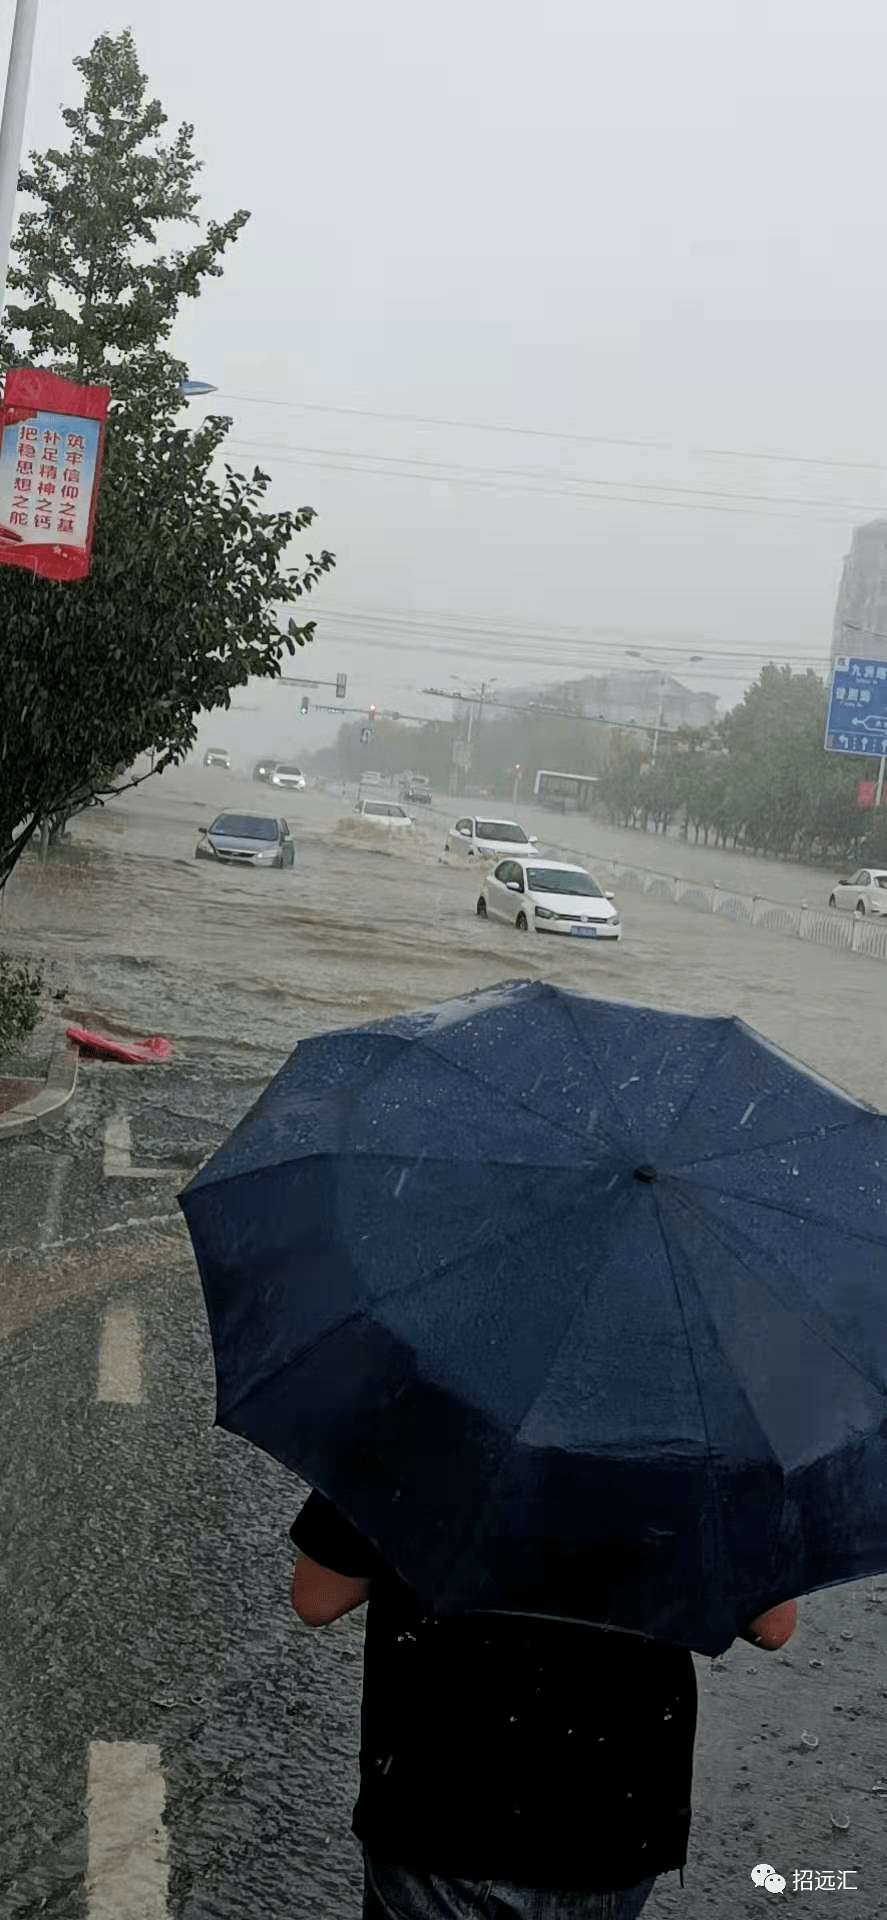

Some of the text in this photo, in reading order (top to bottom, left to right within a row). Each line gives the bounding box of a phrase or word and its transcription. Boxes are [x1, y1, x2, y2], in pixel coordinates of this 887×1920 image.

[9, 426, 38, 526] 把稳思想之舵
[34, 430, 60, 529] 补足精神之钙
[58, 433, 84, 533] 筑牢信仰之基
